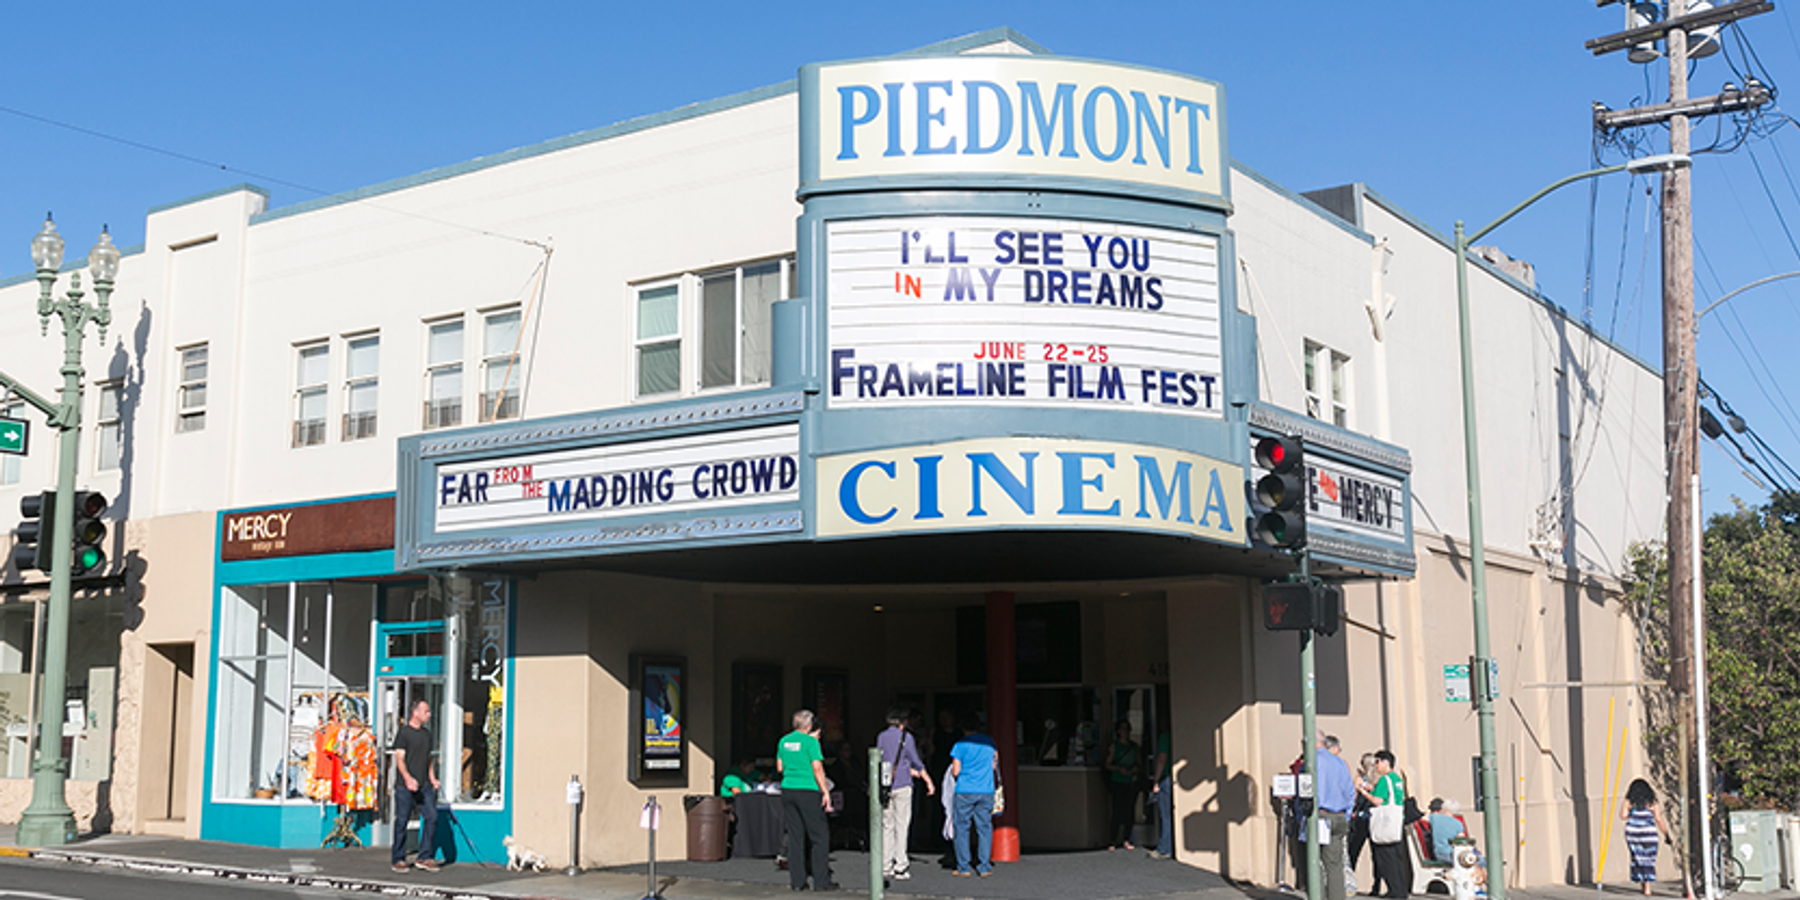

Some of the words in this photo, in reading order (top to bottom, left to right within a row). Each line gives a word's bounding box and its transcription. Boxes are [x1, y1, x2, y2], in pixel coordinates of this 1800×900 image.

[836, 79, 1211, 176] PIEDMONT
[901, 230, 969, 265] I'LL
[995, 230, 1064, 265] SEE
[1082, 234, 1150, 272] YOU
[895, 271, 922, 298] IN
[943, 267, 1001, 302] MY
[1024, 270, 1163, 311] DREAMS
[831, 348, 1026, 398] FRAMELINE
[1047, 364, 1126, 401] FILM
[1141, 368, 1217, 409] FEST
[974, 341, 1026, 360] JUNE
[1043, 343, 1109, 363] 22-25
[441, 471, 489, 505] FAR
[493, 465, 533, 484] FROM
[522, 481, 543, 499] THE
[548, 468, 674, 513] MADDING
[692, 455, 797, 499] CROWD
[838, 451, 1235, 533] CINEMA
[1339, 475, 1393, 529] MERCY
[227, 512, 293, 542] MERCY
[480, 580, 502, 688] MERCY
